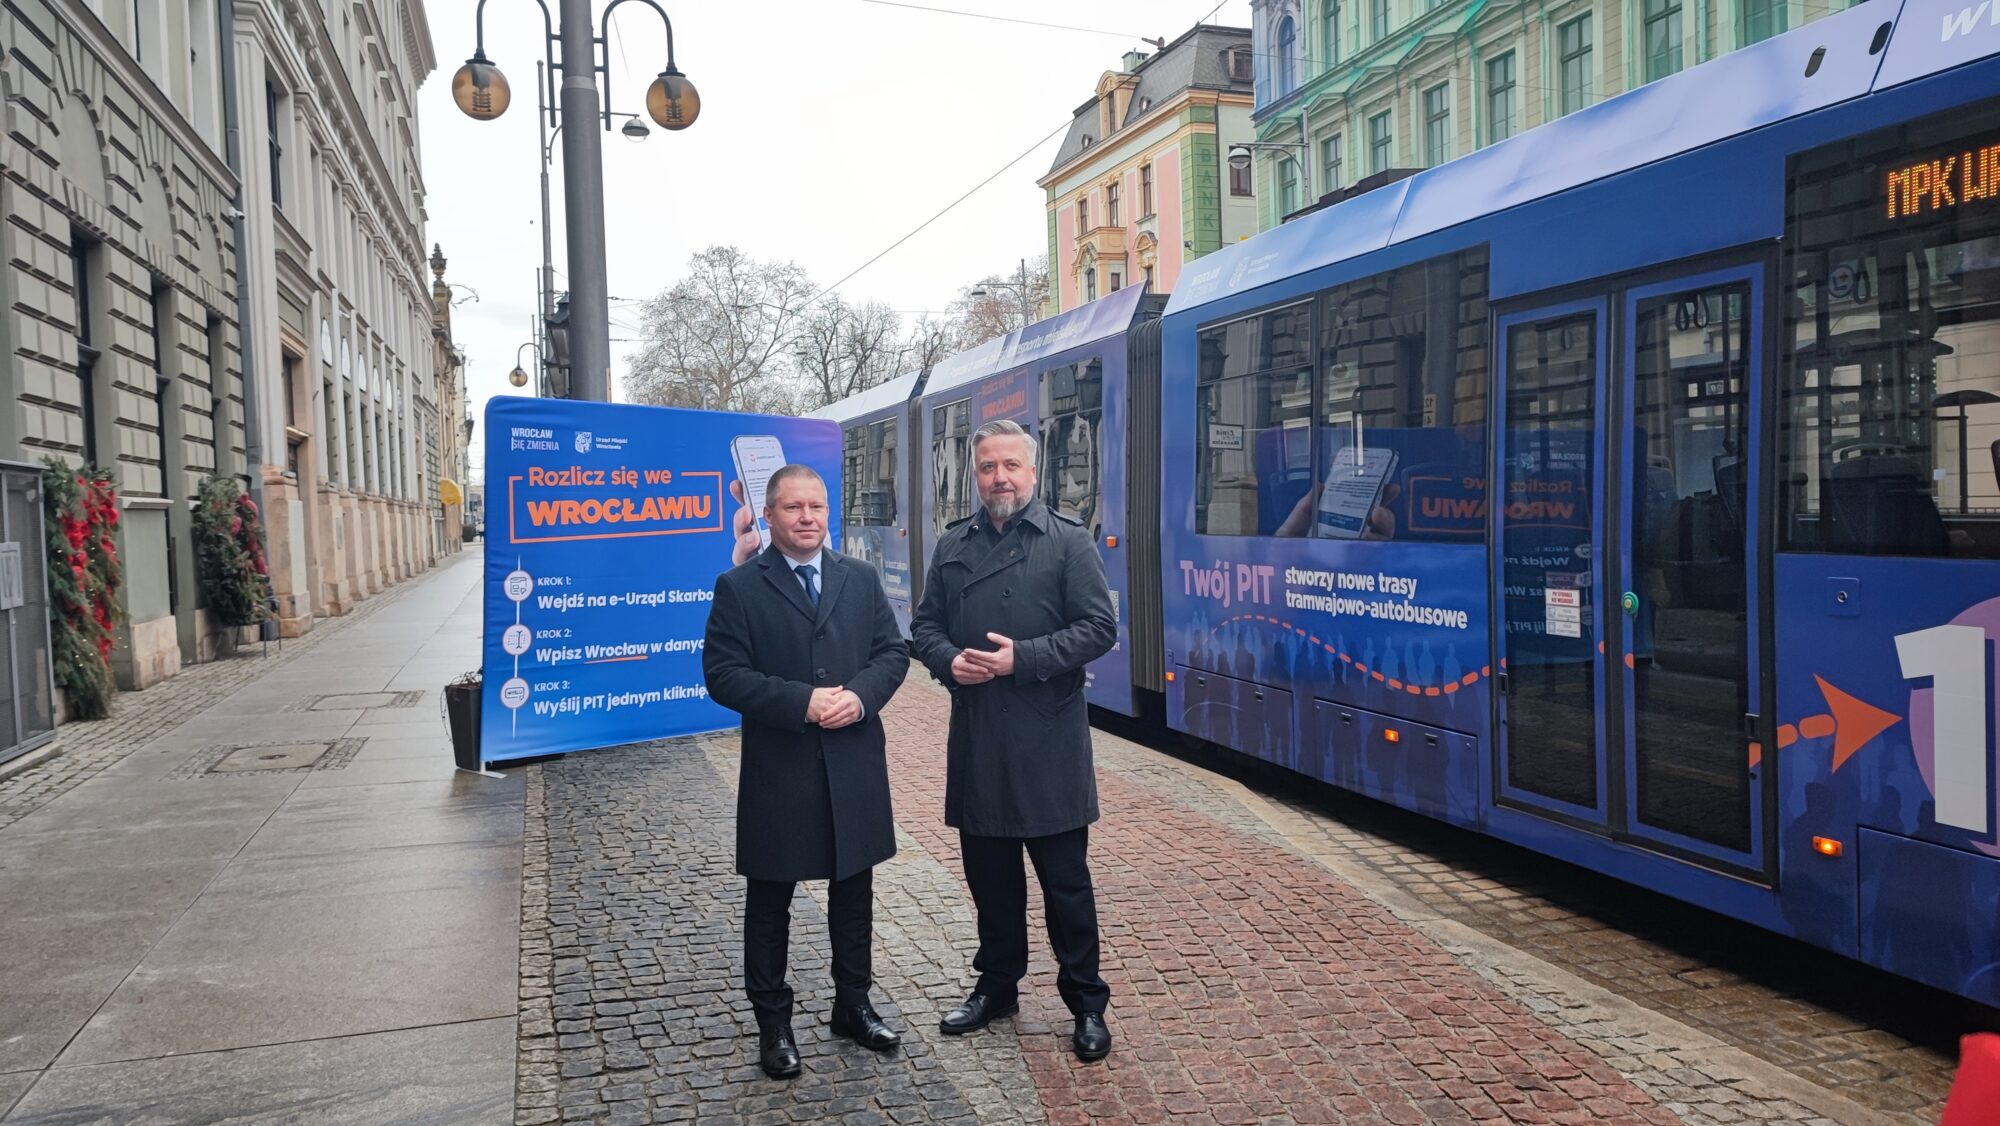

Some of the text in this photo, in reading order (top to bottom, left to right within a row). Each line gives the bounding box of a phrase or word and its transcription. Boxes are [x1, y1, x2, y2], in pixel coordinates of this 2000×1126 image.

[1202, 148, 1214, 228] BANK
[1888, 156, 1956, 219] MPK
[511, 427, 553, 439] WROCŁAW
[513, 439, 560, 451] SIĘ ZMIENIA
[528, 466, 672, 488] Rozlicz się we
[527, 495, 711, 527] WROCŁAWIU
[537, 576, 572, 586] KROK 1:
[1180, 560, 1275, 608] Twój PIT
[1285, 566, 1418, 600] stworzy nowe trasy
[537, 593, 585, 613] Wejdź
[587, 595, 606, 607] na
[609, 590, 666, 607] e-Urząd
[1285, 589, 1468, 629] tramwajowo-autobusowe
[536, 628, 572, 639] KROK 2:
[536, 646, 582, 665] Wpisz
[584, 641, 648, 659] Wrocław
[651, 643, 661, 652] w
[534, 680, 570, 692] KROK 3:
[533, 696, 580, 718] Wyślij
[583, 695, 605, 710] PIT
[606, 691, 660, 711] jednym
